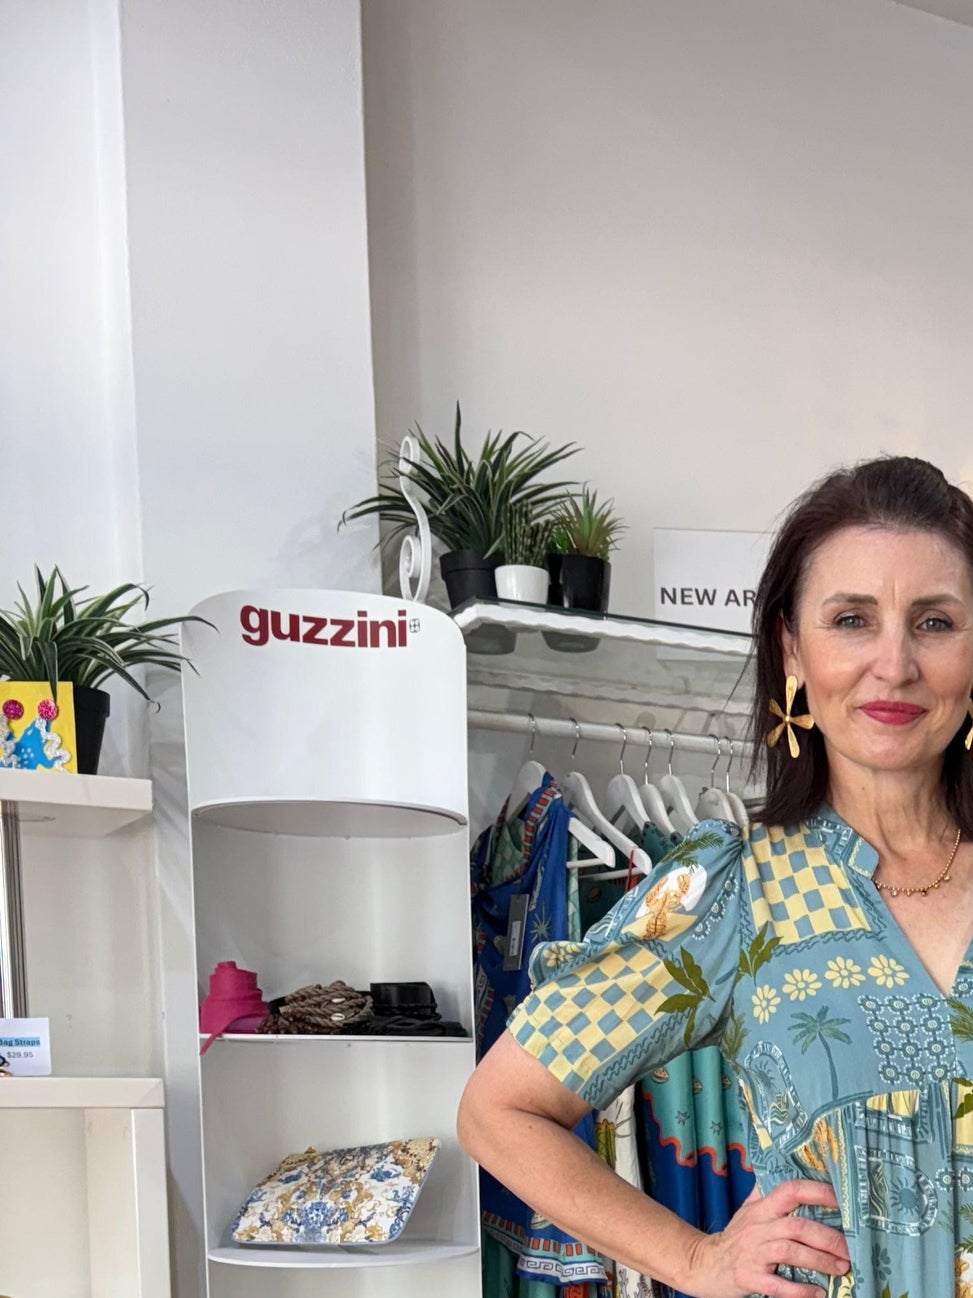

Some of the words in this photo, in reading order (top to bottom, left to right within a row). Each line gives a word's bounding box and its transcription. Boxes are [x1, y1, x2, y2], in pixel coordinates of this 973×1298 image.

[660, 586, 717, 606] NEW
[240, 604, 408, 648] guzzini
[14, 1038, 41, 1047] Straps
